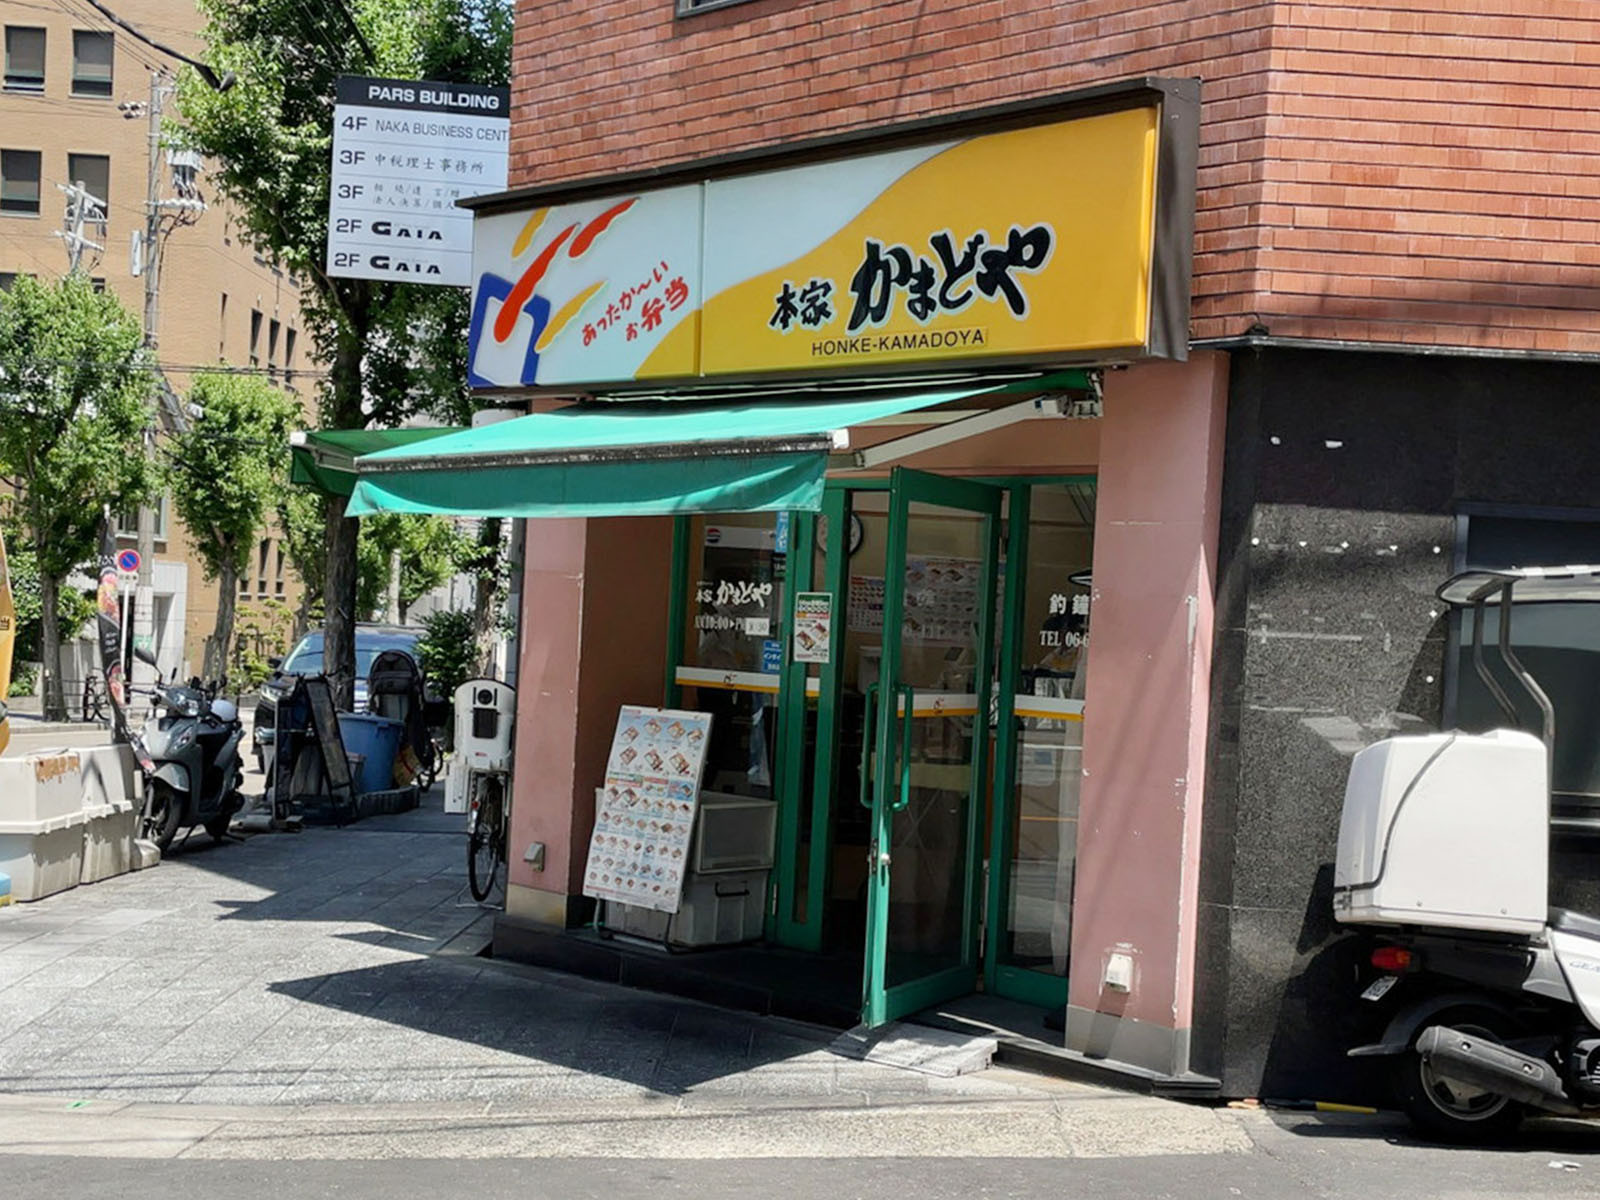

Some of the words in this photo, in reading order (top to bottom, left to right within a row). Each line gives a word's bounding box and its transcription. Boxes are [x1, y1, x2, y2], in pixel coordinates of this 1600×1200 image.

[368, 85, 415, 103] PARS
[419, 90, 500, 110] BUILDING
[341, 116, 368, 131] 4F
[375, 119, 410, 134] NAKA
[413, 122, 474, 139] BUSINESS
[339, 150, 366, 165] 3F
[337, 184, 364, 200] 3F
[336, 218, 362, 233] 2F
[371, 221, 443, 241] GAIA
[334, 252, 361, 267] 2F
[369, 255, 441, 275] GAIA
[768, 280, 833, 331] 本家
[847, 225, 1051, 332] かまどや
[626, 276, 690, 342] お弁当
[811, 329, 985, 356] HONKE-KAMADOYA
[1040, 630, 1062, 647] TEL
